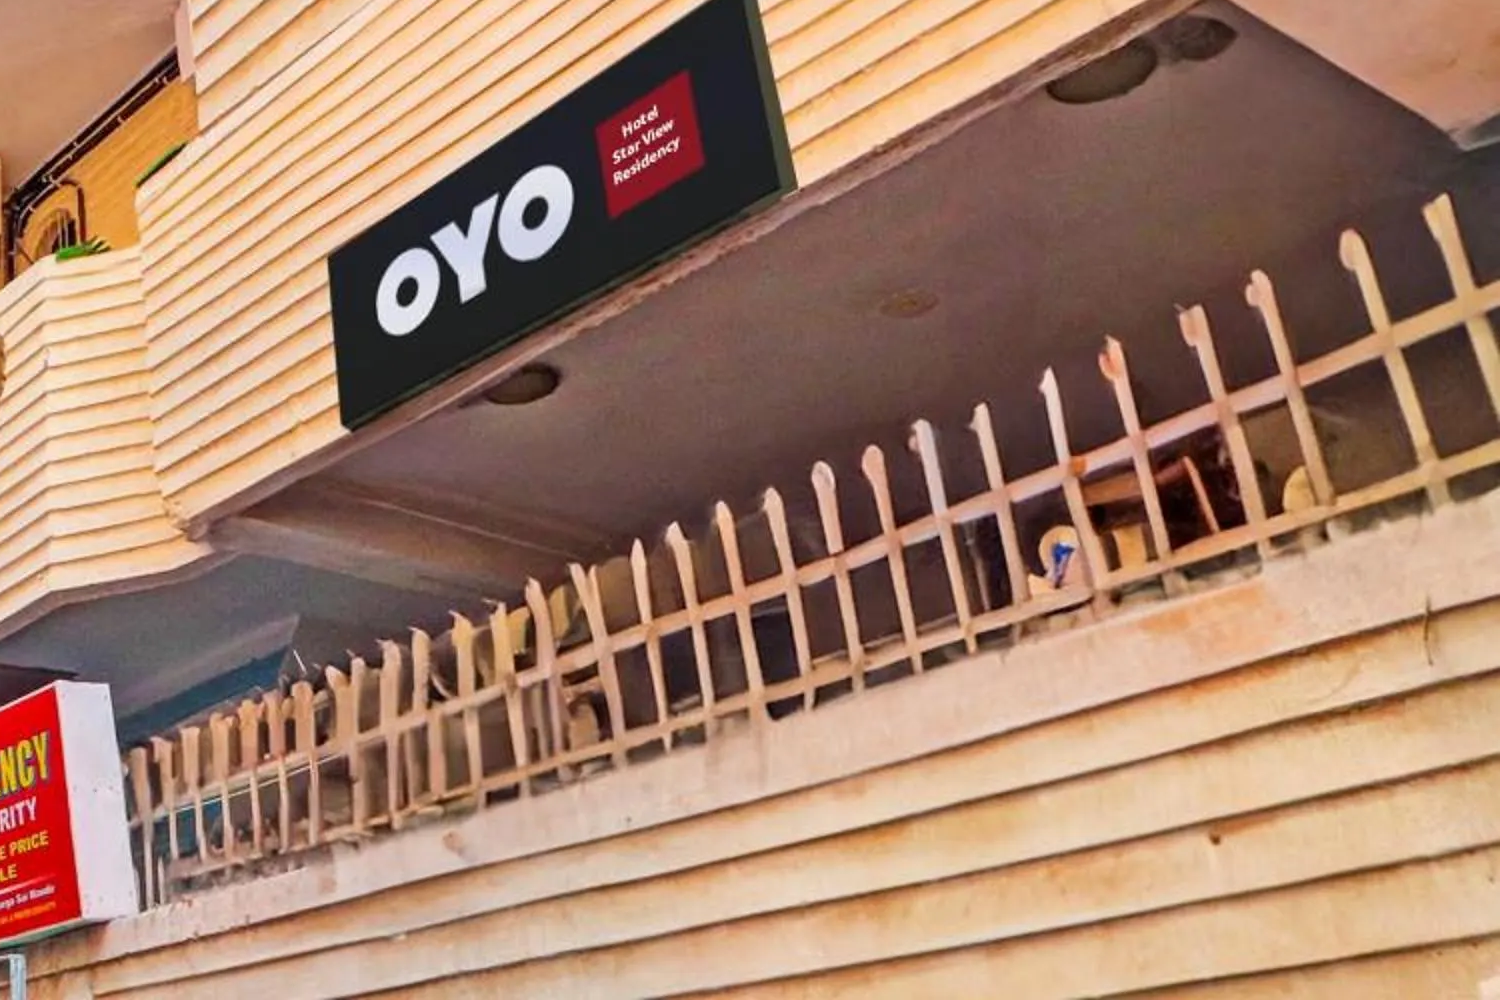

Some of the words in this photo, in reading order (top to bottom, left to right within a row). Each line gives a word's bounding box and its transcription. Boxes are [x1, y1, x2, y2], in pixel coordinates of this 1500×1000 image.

[612, 140, 641, 165] Star
[641, 119, 674, 145] View
[621, 104, 659, 138] Hotel
[612, 136, 680, 186] Residency
[375, 164, 575, 336] OYO
[8, 830, 50, 857] PRICE
